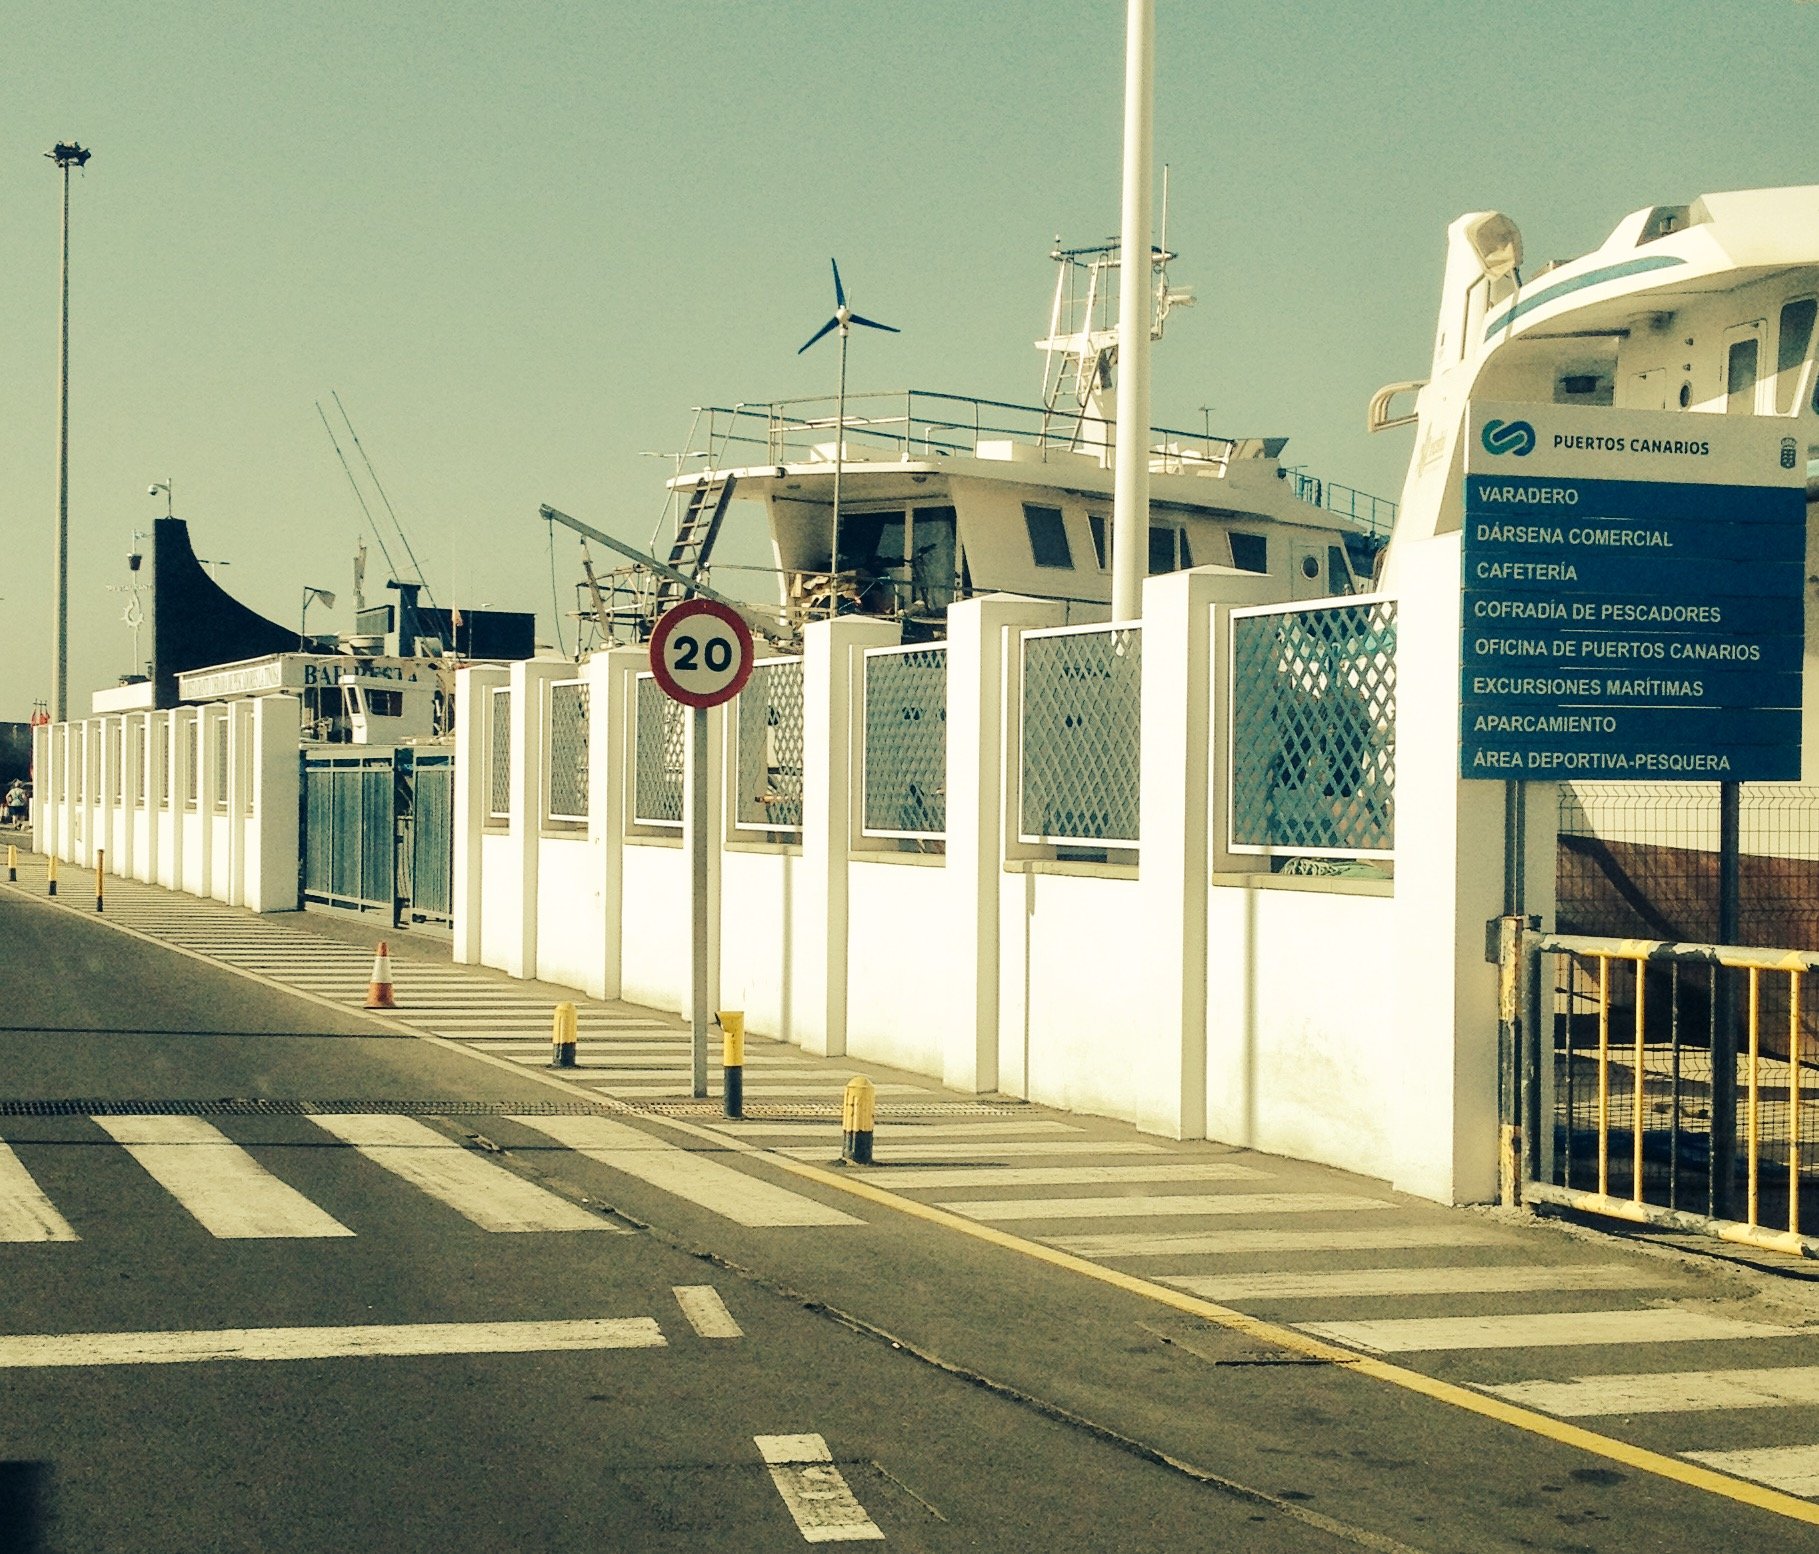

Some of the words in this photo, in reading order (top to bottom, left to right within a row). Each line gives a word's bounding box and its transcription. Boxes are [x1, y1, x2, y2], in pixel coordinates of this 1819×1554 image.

[1553, 434, 1625, 451] PUERTOS
[1630, 438, 1710, 456] CANARIOS
[1478, 486, 1579, 505] VARADERO
[1477, 522, 1565, 544] DÁRSENA
[1568, 528, 1674, 547] COMERCIAL
[1476, 561, 1578, 581] CAFETERÍA
[1474, 600, 1568, 619] COFRADÍA
[1572, 603, 1596, 620] DE
[1601, 604, 1722, 623] PESCADORES
[673, 635, 733, 672] 20
[1475, 638, 1548, 656] OFICINA
[1552, 640, 1577, 657] DE
[1581, 641, 1665, 659] PUERTOS
[1669, 643, 1761, 661] CANARIOS
[1473, 677, 1602, 695] EXCURSIONES
[1606, 677, 1704, 697] MARÍTIMAS
[1473, 715, 1617, 733] APARCAMIENTO
[1472, 747, 1524, 768] ÁREA
[1528, 751, 1731, 771] DEPORTIVA-PESQUERA
